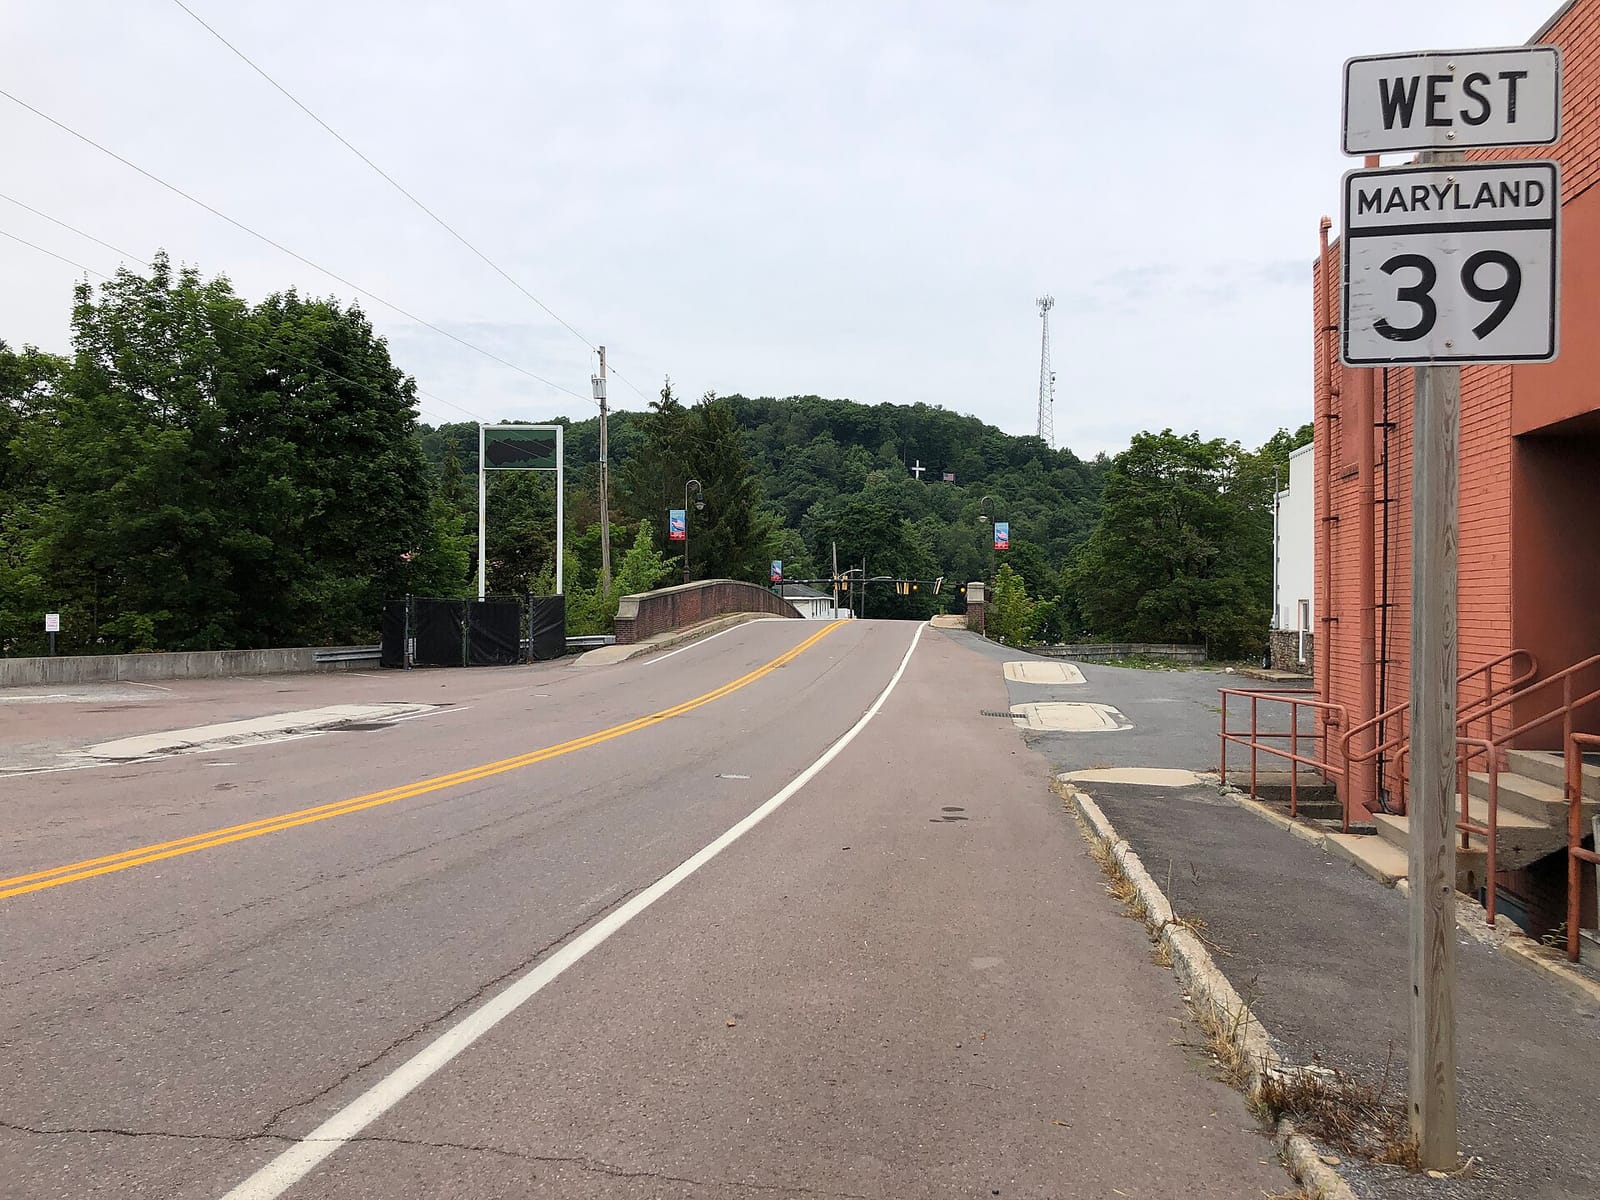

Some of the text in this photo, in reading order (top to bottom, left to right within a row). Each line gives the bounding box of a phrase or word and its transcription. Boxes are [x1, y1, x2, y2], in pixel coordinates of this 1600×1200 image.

[1379, 71, 1527, 130] WEST
[1358, 180, 1544, 215] MARYLAND
[1372, 250, 1521, 341] 39
